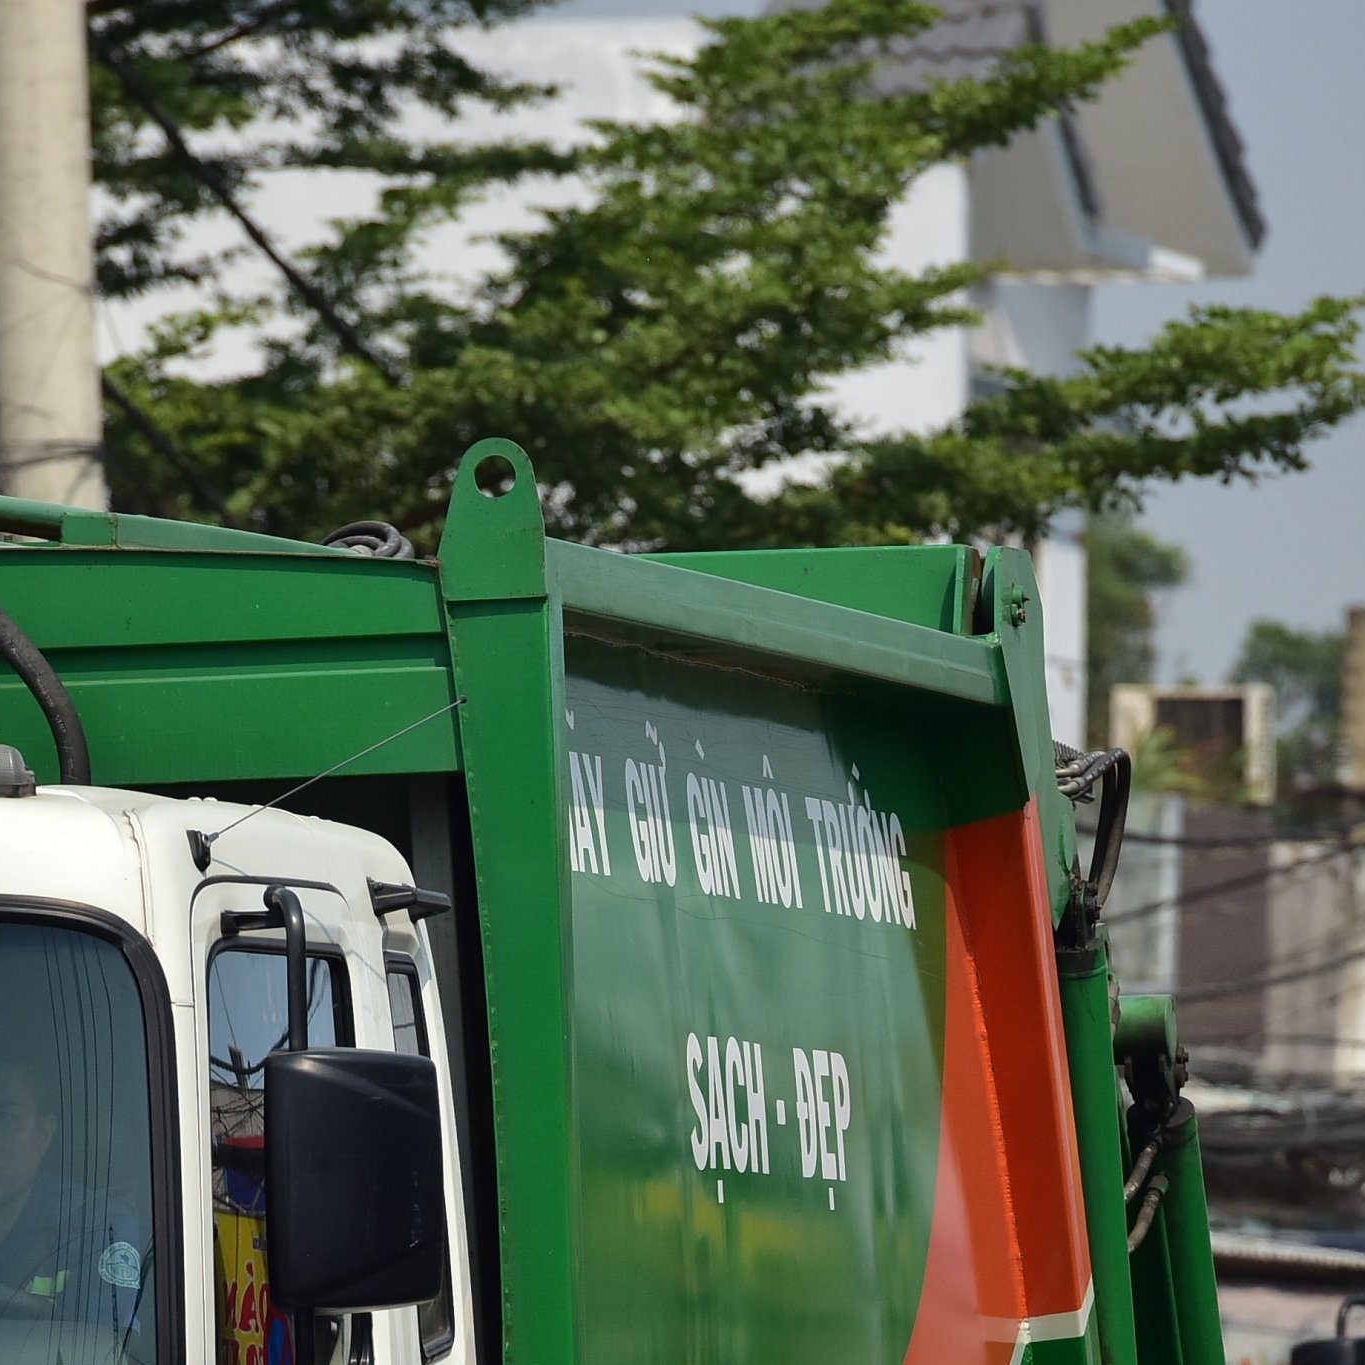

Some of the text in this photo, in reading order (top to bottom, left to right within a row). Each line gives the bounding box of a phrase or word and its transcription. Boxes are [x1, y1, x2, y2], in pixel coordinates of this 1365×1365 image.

[565, 708, 612, 877] ÃY
[686, 738, 741, 900] GÌN
[741, 755, 804, 909] MÔI
[804, 762, 918, 931] TRƯỜNG
[686, 1032, 770, 1204] SẠCH
[792, 1047, 851, 1211] ĐẸP
